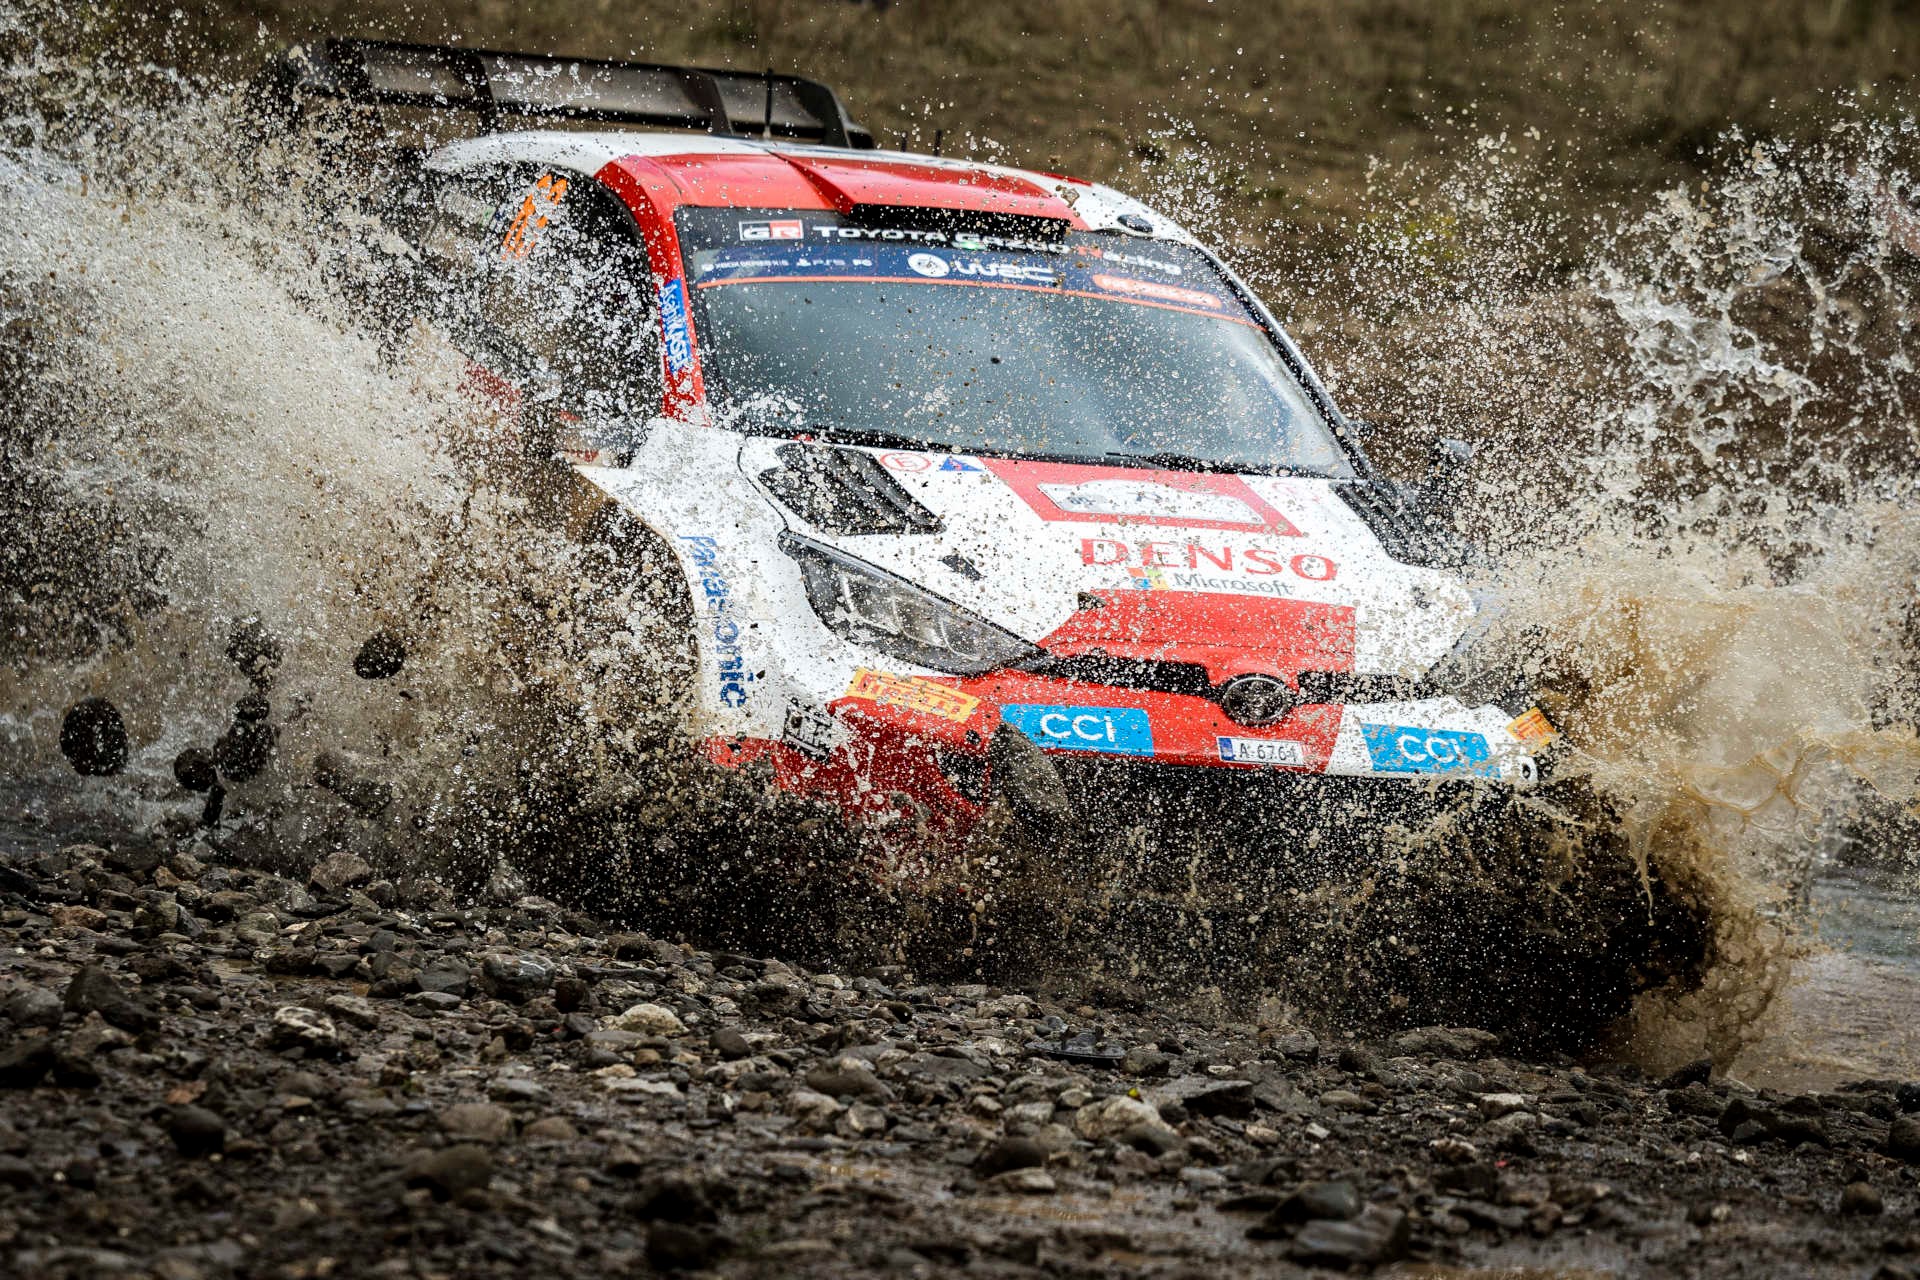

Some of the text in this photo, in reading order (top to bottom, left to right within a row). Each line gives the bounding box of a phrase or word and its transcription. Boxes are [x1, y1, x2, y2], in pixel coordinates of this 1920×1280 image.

[742, 225, 801, 239] GR
[812, 226, 947, 243] TOYOTA
[1080, 537, 1338, 582] DENSO
[1173, 571, 1296, 596] Microsoft
